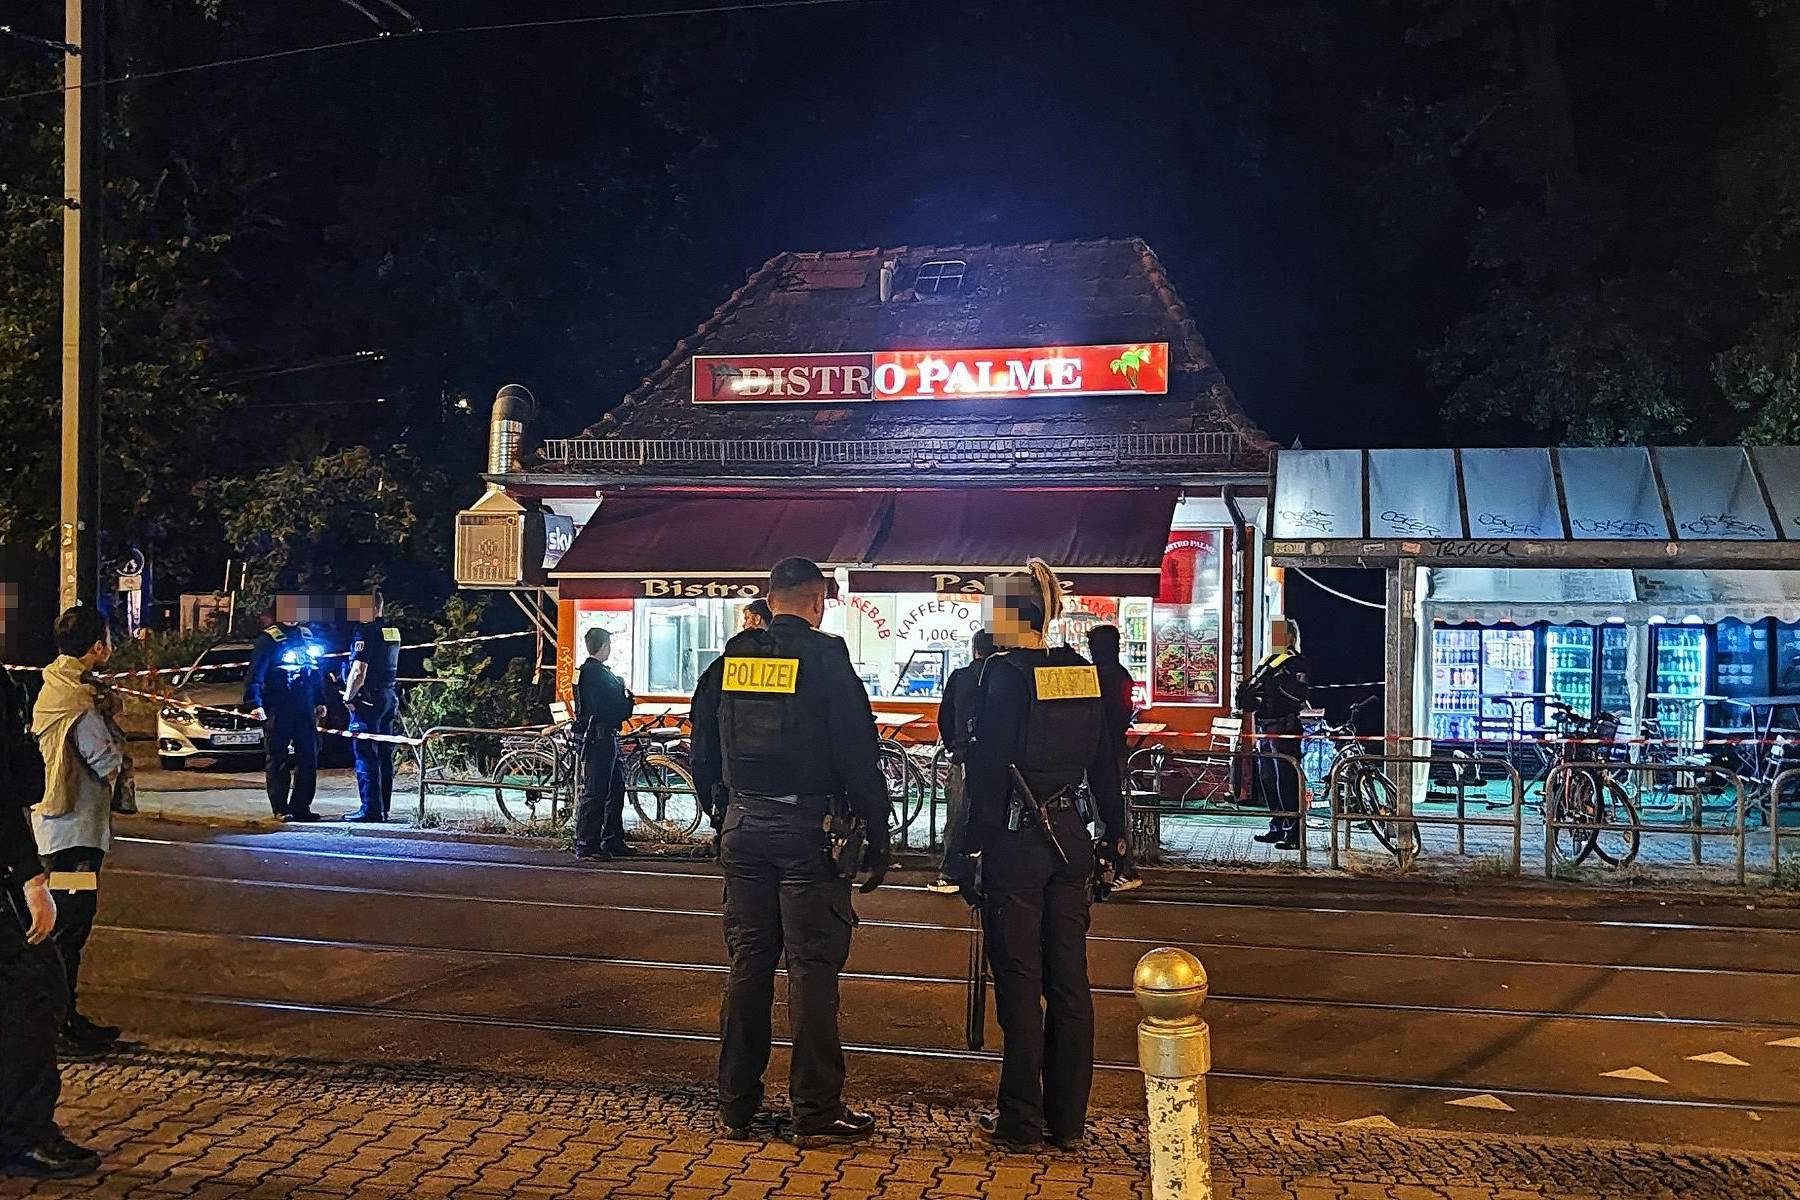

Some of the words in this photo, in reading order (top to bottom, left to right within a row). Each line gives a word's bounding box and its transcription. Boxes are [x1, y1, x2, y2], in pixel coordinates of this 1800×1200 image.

[739, 362, 906, 397] BISTRO
[916, 358, 1083, 395] PALME
[640, 579, 760, 598] Bistro
[851, 595, 891, 639] KEBAB
[896, 600, 945, 640] KAFFEE
[950, 602, 969, 619] TO
[918, 628, 959, 642] 1,00€
[726, 662, 794, 689] POLIZEI
